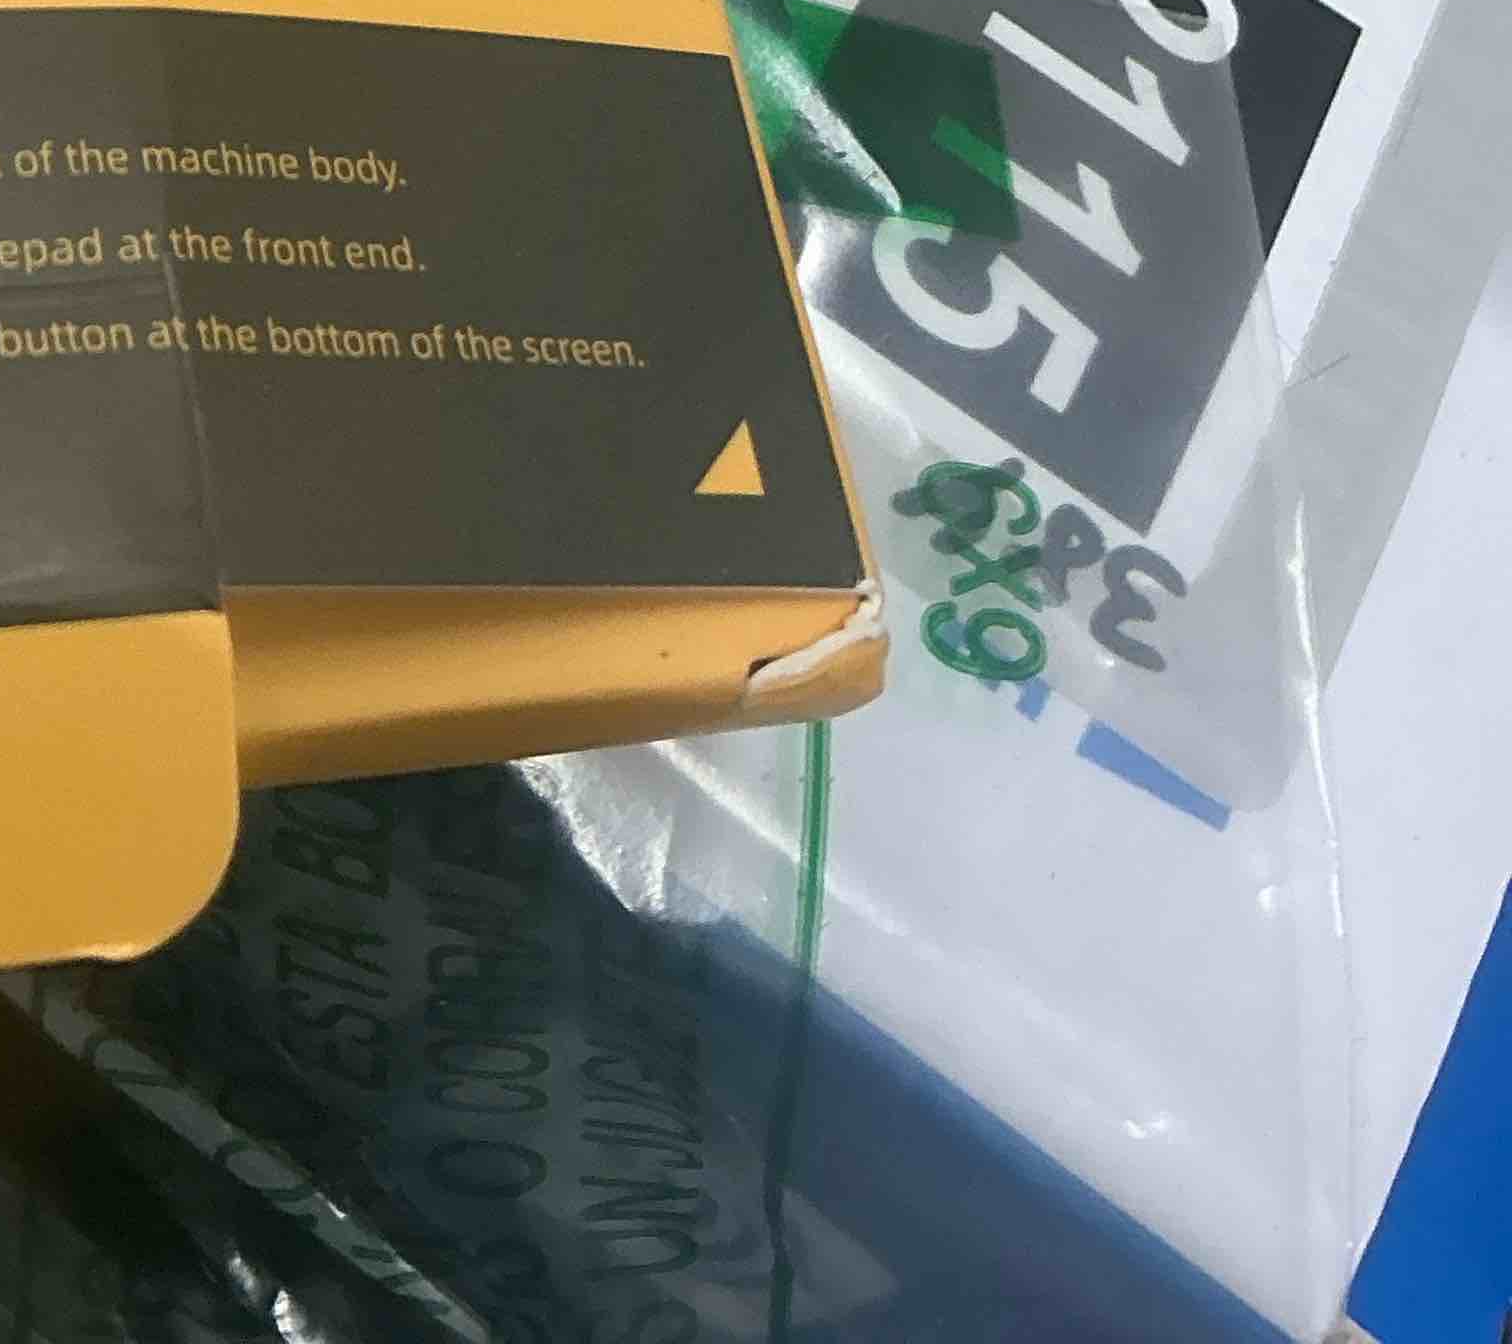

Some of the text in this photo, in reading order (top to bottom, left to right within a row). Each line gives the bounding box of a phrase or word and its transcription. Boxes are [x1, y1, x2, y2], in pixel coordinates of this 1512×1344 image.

[14, 140, 54, 179] of
[64, 138, 130, 176] the
[140, 142, 298, 180] machine
[308, 146, 408, 192] body.
[119, 230, 159, 261] at
[168, 226, 234, 264] the
[242, 226, 336, 271] front
[345, 236, 426, 274] end.
[146, 315, 189, 351] at
[196, 318, 258, 355] the
[267, 320, 400, 362] bottom
[411, 323, 449, 362] of
[454, 327, 513, 366] the
[521, 335, 646, 370] screen.
